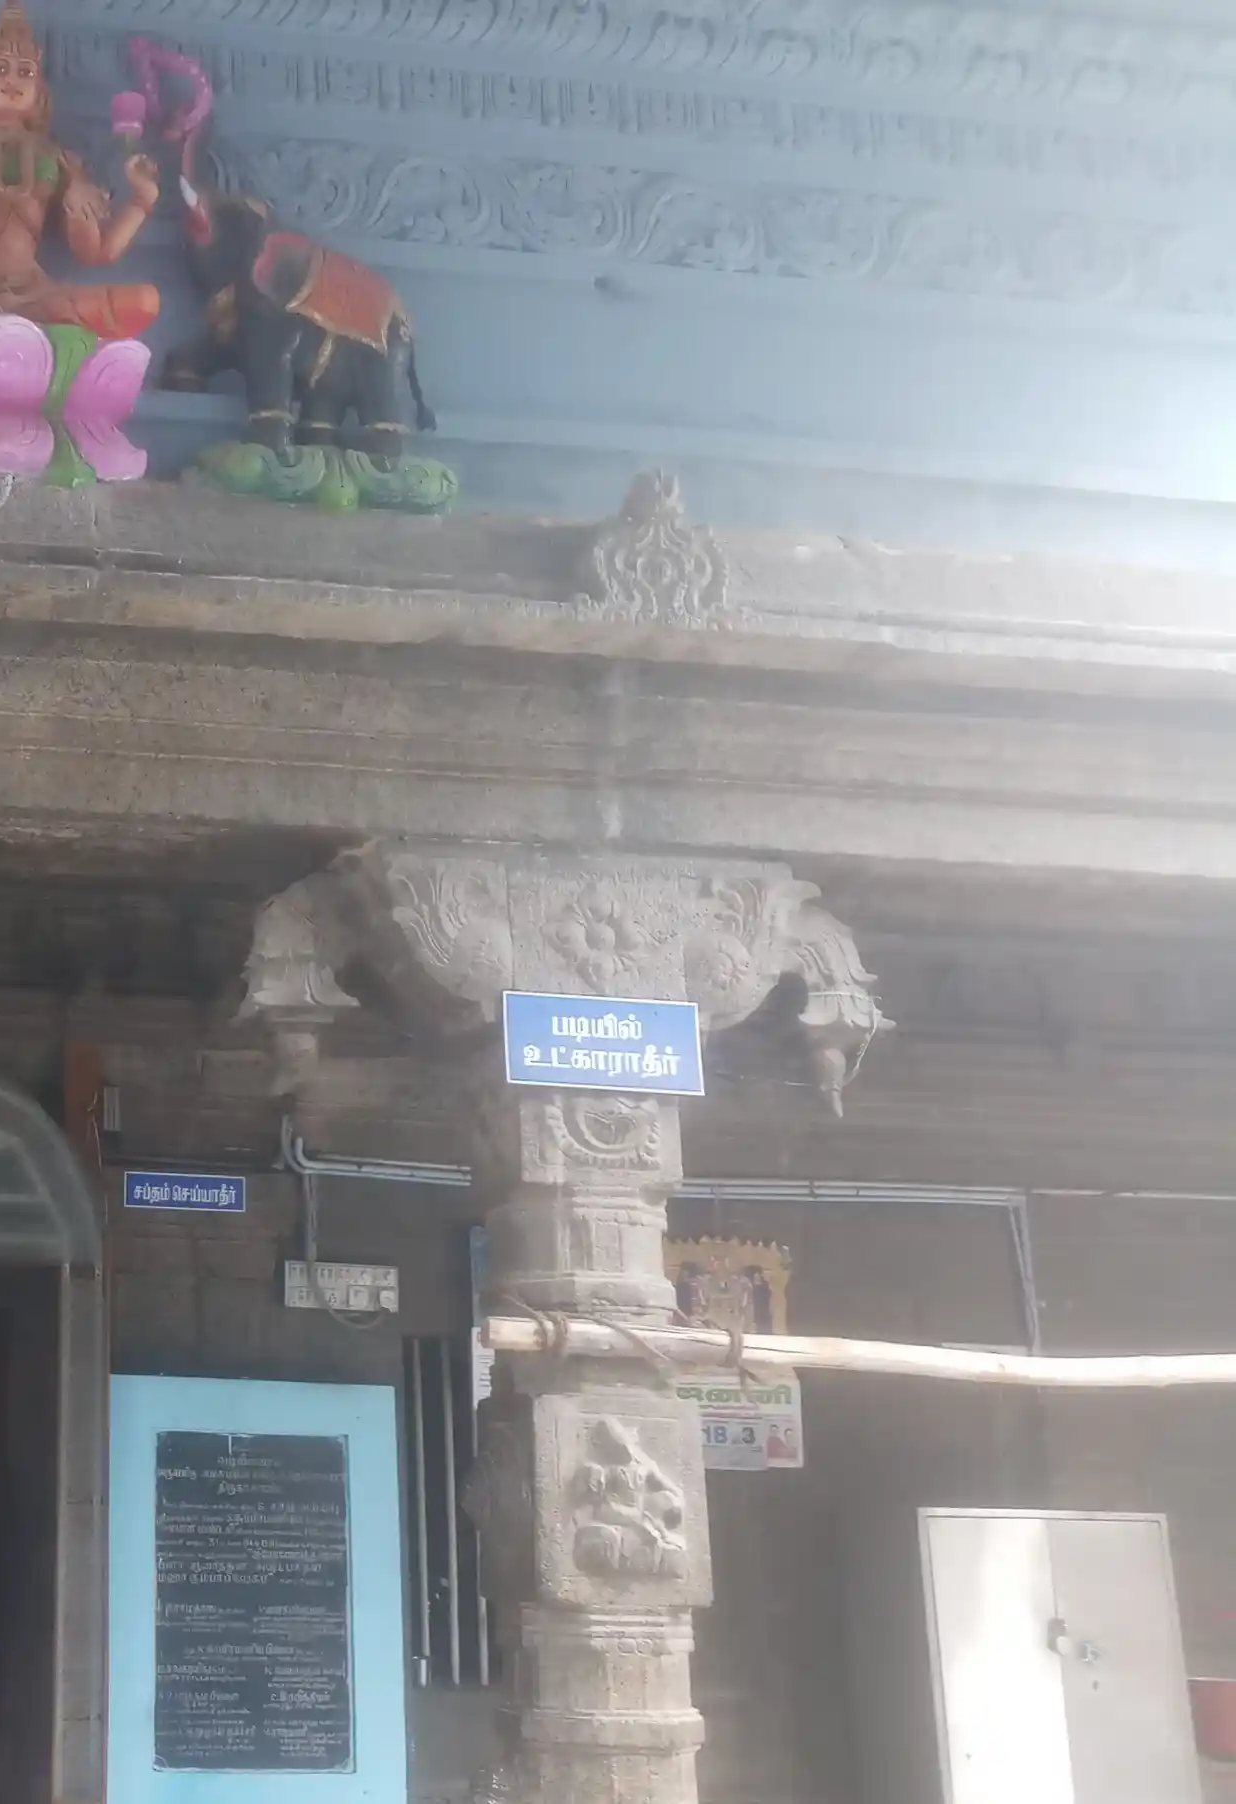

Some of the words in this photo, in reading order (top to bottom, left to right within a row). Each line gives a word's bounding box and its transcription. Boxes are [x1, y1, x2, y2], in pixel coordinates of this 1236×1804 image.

[552, 1012, 643, 1043] படியில்
[523, 1044, 681, 1078] உட்காராதீர்
[134, 1182, 170, 1203] சப்தம்
[172, 1184, 236, 1206] செய்யாதீர்
